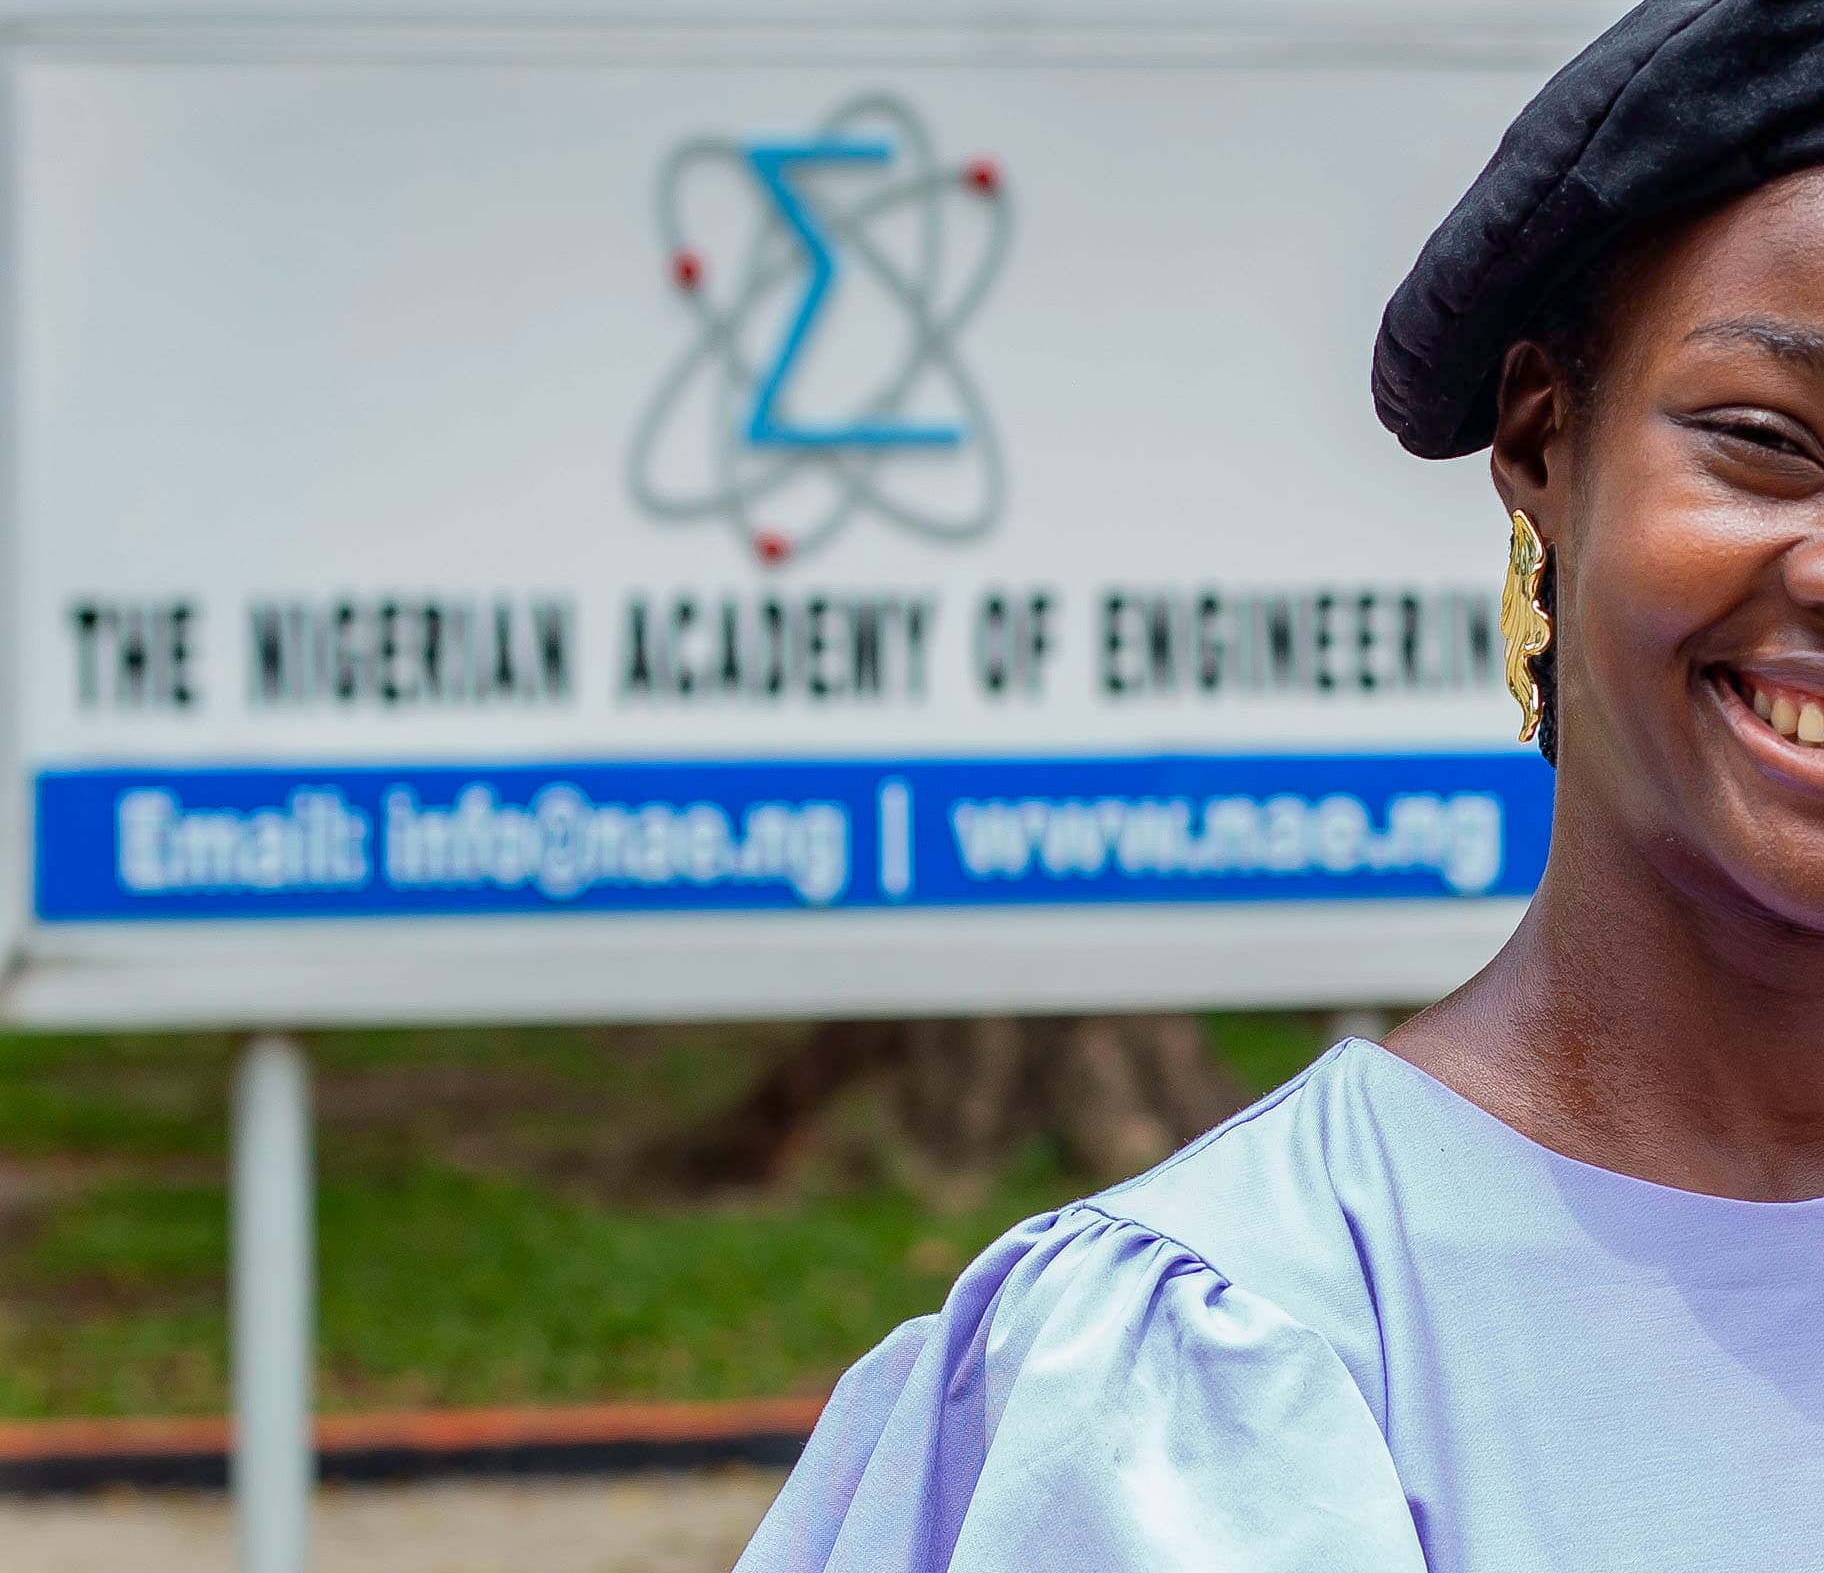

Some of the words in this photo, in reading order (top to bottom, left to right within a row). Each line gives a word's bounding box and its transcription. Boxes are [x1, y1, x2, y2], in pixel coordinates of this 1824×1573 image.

[70, 596, 203, 710] THE
[247, 594, 575, 712] NIGERIAN
[616, 590, 938, 706] ACADEMY
[974, 590, 1058, 704] OF
[1102, 586, 1504, 700] ENGINEERIN
[118, 788, 371, 892] Email:
[386, 784, 850, 904] info@nae.ng
[950, 790, 1502, 894] www.nae.ng
